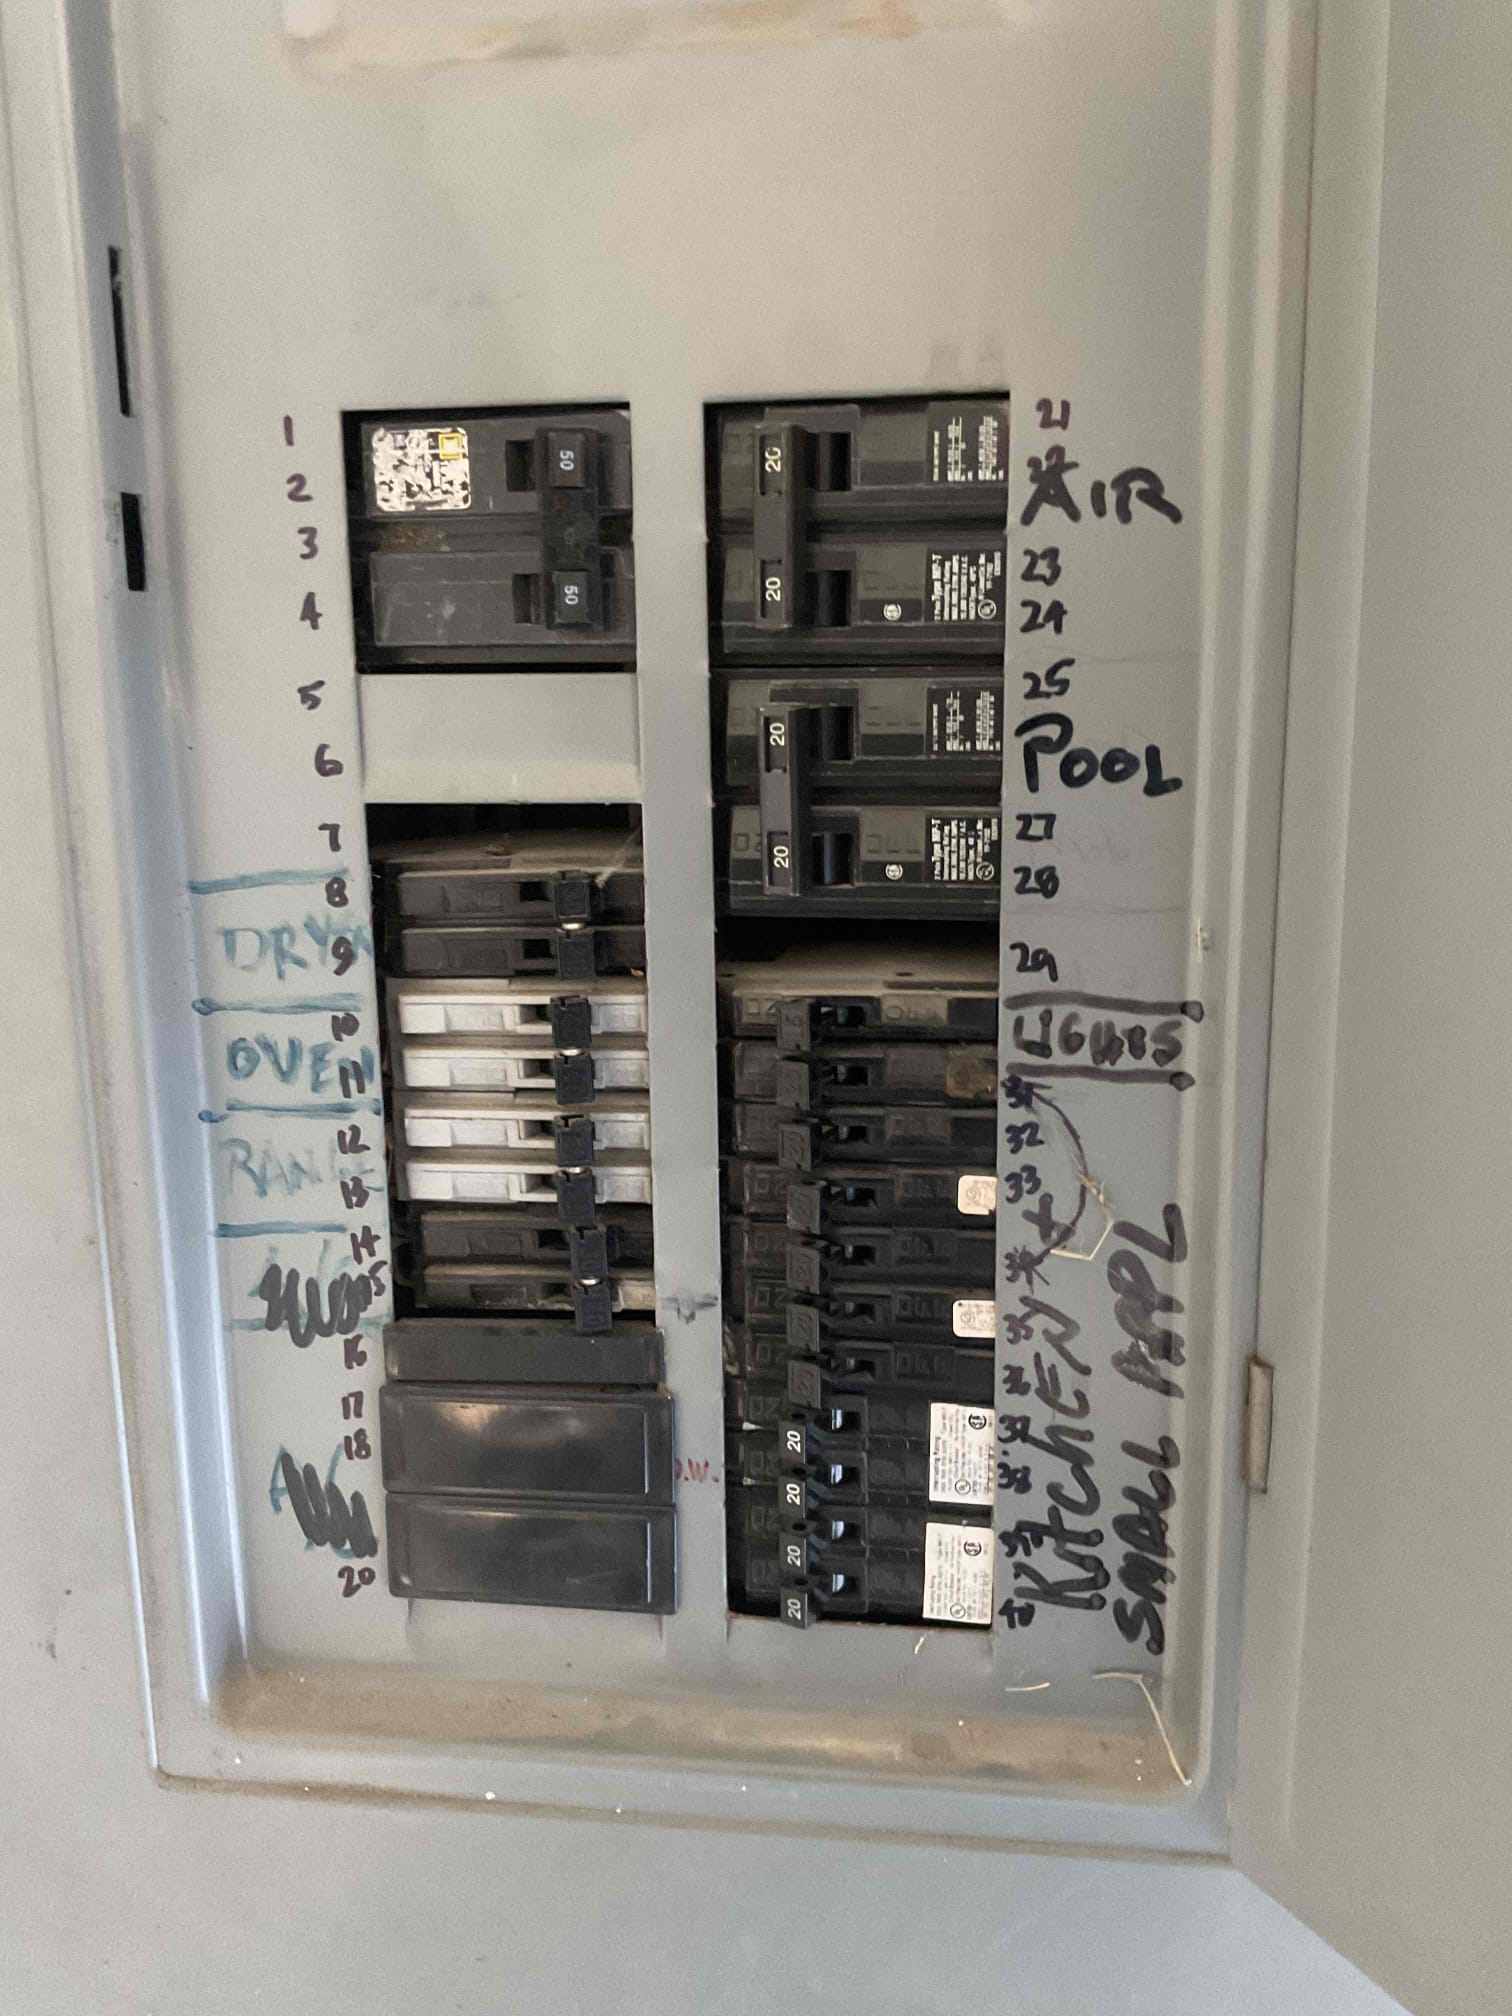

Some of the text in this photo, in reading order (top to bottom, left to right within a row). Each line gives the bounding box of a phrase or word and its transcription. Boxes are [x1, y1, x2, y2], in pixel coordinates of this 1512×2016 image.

[1035, 397, 1071, 431] 21
[283, 415, 295, 447] 1
[559, 449, 575, 472] 50
[764, 446, 782, 473] 20
[286, 473, 313, 503] 2
[1020, 466, 1183, 526] AIR
[297, 527, 319, 560] 3
[1020, 546, 1062, 586] 23
[564, 584, 579, 606] 50
[764, 576, 782, 602] 20
[300, 592, 323, 630] 4
[1020, 599, 1068, 634] 24
[1022, 658, 1076, 699] 25
[297, 680, 325, 710] 5
[769, 722, 785, 747] 20
[313, 743, 344, 777] 6
[1014, 712, 1183, 797] POOL
[318, 823, 342, 852] 7
[1015, 813, 1057, 842] 27
[773, 845, 789, 869] 20
[325, 876, 350, 907] 8
[1013, 865, 1060, 899] 28
[331, 936, 354, 976] 9
[1009, 941, 1059, 983] 29
[331, 1012, 360, 1042] 10
[339, 1060, 366, 1099] 11
[337, 1124, 371, 1155] 12
[1005, 1121, 1045, 1154] 32
[340, 1175, 370, 1210] 13
[1004, 1164, 1042, 1204] 33
[350, 1225, 382, 1265] 14
[344, 1334, 368, 1370] 16
[341, 1391, 365, 1420] 17
[343, 1428, 372, 1461] 18
[786, 1430, 801, 1453] 20
[786, 1483, 801, 1505] 20
[787, 1545, 801, 1567] 20
[338, 1566, 377, 1598] 20
[787, 1598, 801, 1620] 20
